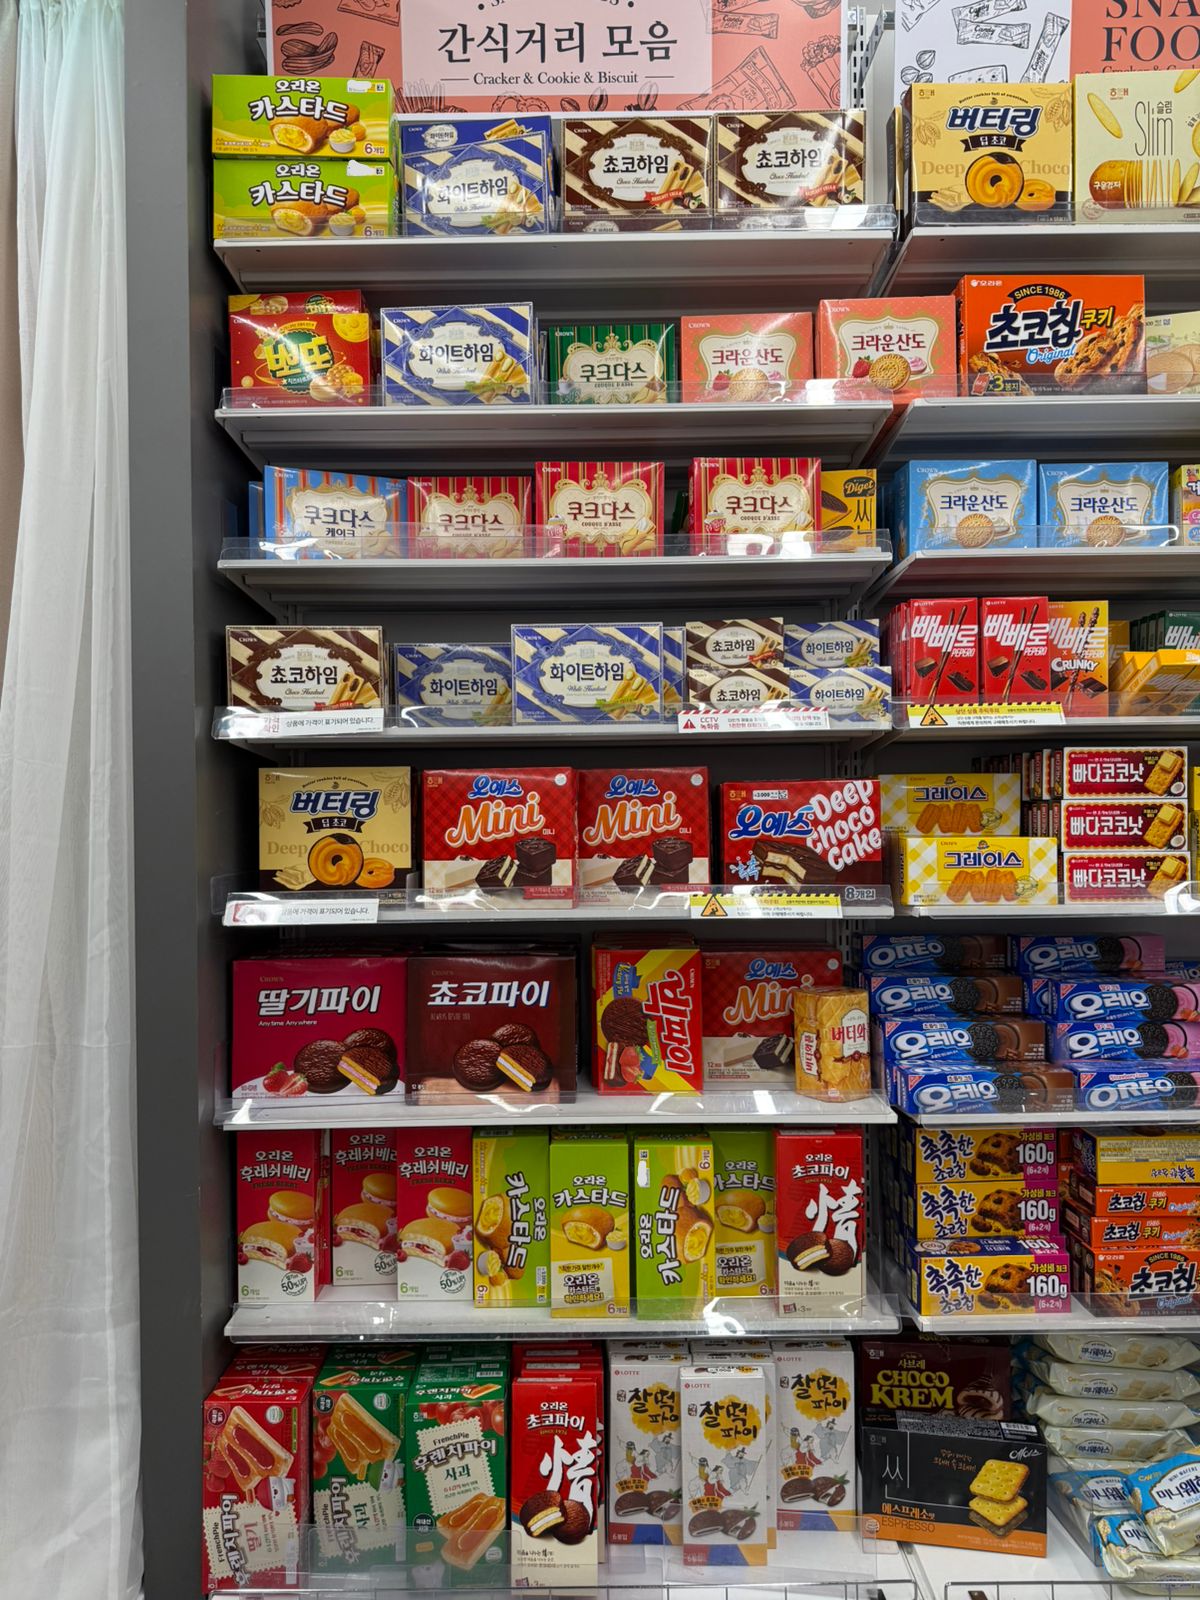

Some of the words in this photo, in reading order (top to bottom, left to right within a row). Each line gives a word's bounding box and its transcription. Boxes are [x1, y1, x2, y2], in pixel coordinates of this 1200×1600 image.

[438, 22, 585, 63] 간식거리
[602, 20, 678, 62] 모음
[276, 79, 320, 93] 오리온
[473, 72, 520, 85] Cracker
[523, 73, 535, 84] &
[537, 71, 580, 84] Cookie
[583, 72, 594, 83] &
[598, 71, 639, 84] Biscuit
[249, 96, 349, 123] 카스타드
[1157, 101, 1172, 114] 슬림
[946, 105, 1043, 137] 버터링
[1135, 101, 1173, 156] Slim
[980, 136, 989, 146] 딥
[991, 136, 1006, 146] 초코
[602, 154, 669, 174] 쵸코하임
[757, 149, 821, 169] 쵸코하임
[921, 160, 965, 177] Deep
[1023, 159, 1070, 175] Choco
[276, 163, 320, 177] 오리온
[249, 180, 349, 207] 카스타드
[1014, 285, 1043, 300] SINCE
[1043, 286, 1066, 300] 1986
[985, 299, 1083, 352] 초코칩
[1081, 306, 1115, 329] 쿠키
[852, 333, 925, 353] 크라운산도
[419, 342, 494, 365] 화이트하임
[711, 346, 784, 365] 크라운산도
[1026, 344, 1076, 364] Original
[580, 362, 647, 382] 쿠크다스
[567, 501, 635, 521] 쿠크다스
[726, 495, 794, 515] 쿠크다스
[940, 494, 1009, 511] 크라운산도
[1070, 497, 1138, 513] 크라운산도
[304, 505, 375, 529] 쿠크다스
[439, 513, 505, 531] 쿠크다스
[326, 527, 355, 538] 케이크
[911, 615, 978, 652] 빼빼로
[983, 614, 1049, 651] 빼빼로
[1048, 617, 1108, 654] 빼빼로
[712, 639, 756, 653] 쵸코하임
[951, 648, 976, 657] PEPERO
[1024, 646, 1047, 656] PEPERO
[270, 665, 338, 685] 쵸코하임
[550, 662, 625, 684] 화이트하임
[1051, 658, 1100, 672] CRUNKY
[430, 678, 498, 696] 화이트하임
[717, 688, 761, 701] 쵸코하임
[1072, 763, 1144, 783] 빠다코코낫
[469, 775, 524, 799] 오예스
[605, 775, 660, 798] 오예스
[914, 786, 988, 802] 그레이스
[289, 788, 383, 820] 버터링
[809, 781, 874, 822] Deep
[322, 818, 331, 828] 딥
[332, 818, 347, 828] 초코
[445, 791, 545, 848] Mini
[582, 791, 682, 847] Mini
[728, 804, 814, 840] 오예스
[1070, 816, 1143, 836] 빠다코코낫
[267, 841, 308, 858] Deep
[360, 840, 409, 855] Choco
[944, 851, 1024, 868] 그레이스
[1073, 869, 1146, 888] 빠다코코낫
[845, 887, 876, 900] 8개입
[870, 942, 943, 966] OREO
[1029, 943, 1099, 970] 오레오
[745, 958, 798, 980] 오예스
[258, 985, 381, 1016] 딸기파이
[880, 984, 953, 1012] 오레오
[1069, 991, 1150, 1020] 오레오
[895, 1029, 972, 1059] 오레오
[1069, 1029, 1141, 1058] 오레오
[917, 1081, 998, 1112] 오레오
[1090, 1079, 1172, 1107] OREO
[350, 1134, 386, 1145] 오리온
[920, 1130, 974, 1165] 촉촉한
[1020, 1133, 1043, 1142] 가성비
[255, 1150, 293, 1161] 오리온
[414, 1146, 452, 1158] 오리온
[805, 1153, 833, 1162] 오리온
[1016, 1143, 1054, 1164] 160g
[240, 1163, 311, 1182] 후레쉬베리
[400, 1160, 469, 1178] 후레쉬베리
[725, 1160, 757, 1171] 오리온
[792, 1163, 849, 1180] 초코파이
[933, 1161, 967, 1182] 초코칩
[572, 1175, 606, 1186] 오리온
[553, 1187, 628, 1208] 카스타드
[921, 1185, 975, 1222] 촉촉한
[1021, 1189, 1045, 1198] 가성비
[1107, 1192, 1146, 1213] 초코칩
[1148, 1197, 1167, 1210] 쿠키
[506, 1171, 531, 1267] 카스타드
[533, 1197, 547, 1241] 오리온
[1017, 1200, 1056, 1221] 160g
[639, 1214, 652, 1259] 오리온
[656, 1186, 682, 1286] 카스타드
[934, 1217, 968, 1239] 초코칩
[1103, 1222, 1141, 1242] 초코칩
[1142, 1226, 1160, 1239] 쿠키
[717, 1255, 752, 1266] 오리온
[1030, 1263, 1055, 1273] 가성비
[1148, 1254, 1169, 1263] SINCE
[281, 1281, 298, 1293] 50%
[563, 1273, 599, 1286] 오리온
[925, 1258, 983, 1296] 촉촉한
[1027, 1274, 1067, 1298] 160g
[1127, 1261, 1197, 1300] 초코칩
[939, 1293, 974, 1315] 초코칩
[898, 1358, 926, 1369] 사브레
[791, 1374, 837, 1399] 찰떡
[876, 1369, 950, 1387] CHOCO
[540, 1402, 568, 1411] 오리온
[628, 1387, 676, 1414] 찰떡
[812, 1399, 847, 1411] 파이
[870, 1384, 955, 1409] KREM
[526, 1413, 585, 1432] 초코파이
[699, 1401, 747, 1428] 찰떡
[433, 1431, 470, 1446] FrenchPie
[721, 1426, 757, 1440] 파이
[413, 1439, 497, 1471] 후렌치파이
[444, 1465, 471, 1482] 사과
[881, 1517, 936, 1533] ESPRESSO
[213, 1521, 225, 1563] FrenchPie
